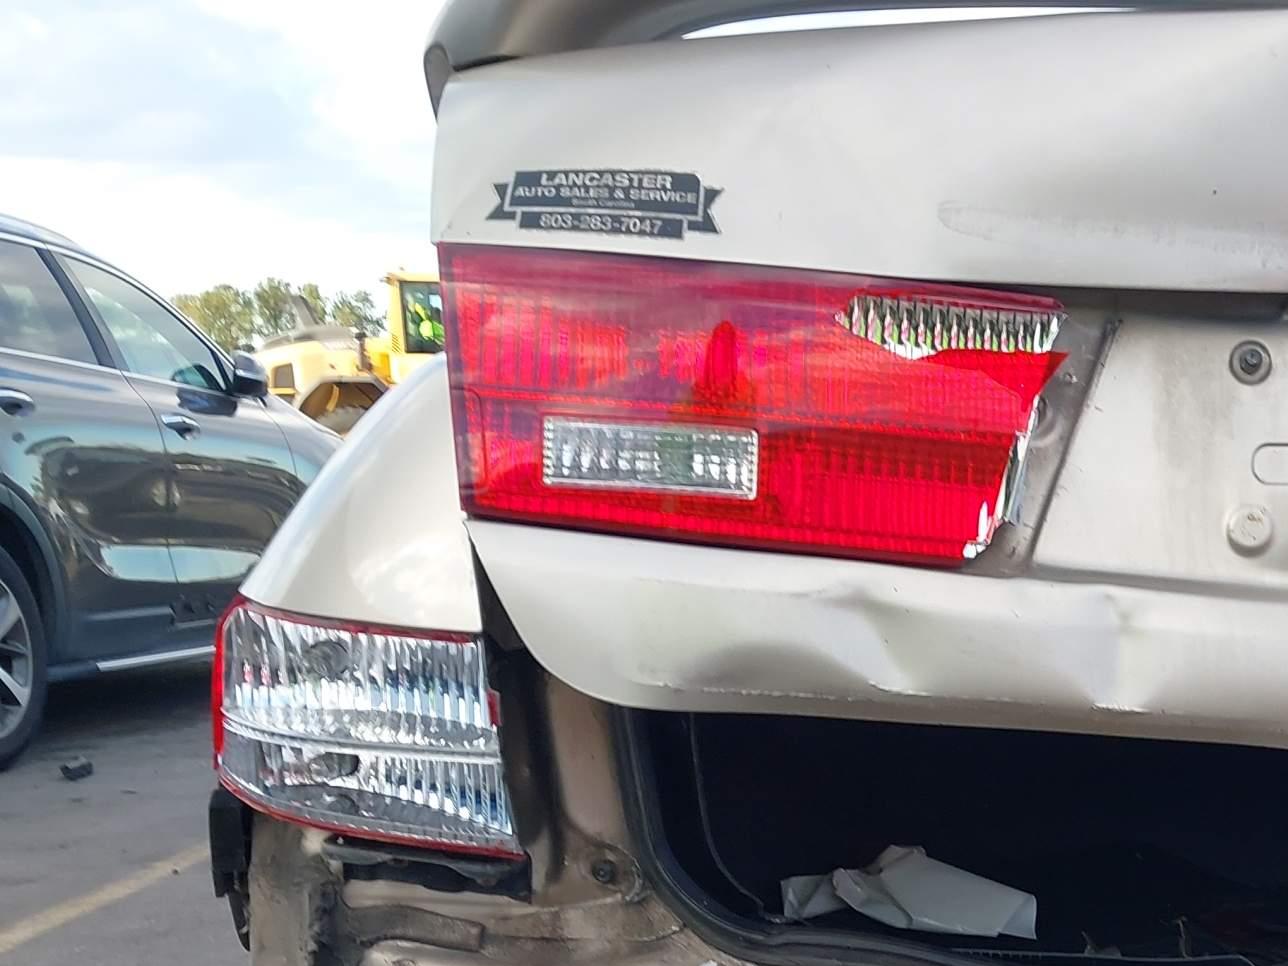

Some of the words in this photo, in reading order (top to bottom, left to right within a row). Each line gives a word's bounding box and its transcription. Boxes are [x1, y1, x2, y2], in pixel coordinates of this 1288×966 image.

[540, 172, 672, 188] LANCASTER
[514, 187, 556, 198] AUTO
[559, 187, 609, 199] SALES
[613, 188, 625, 200] &
[629, 188, 697, 203] SERVICE
[572, 199, 597, 208] South
[539, 214, 663, 234] 803-283-7047
